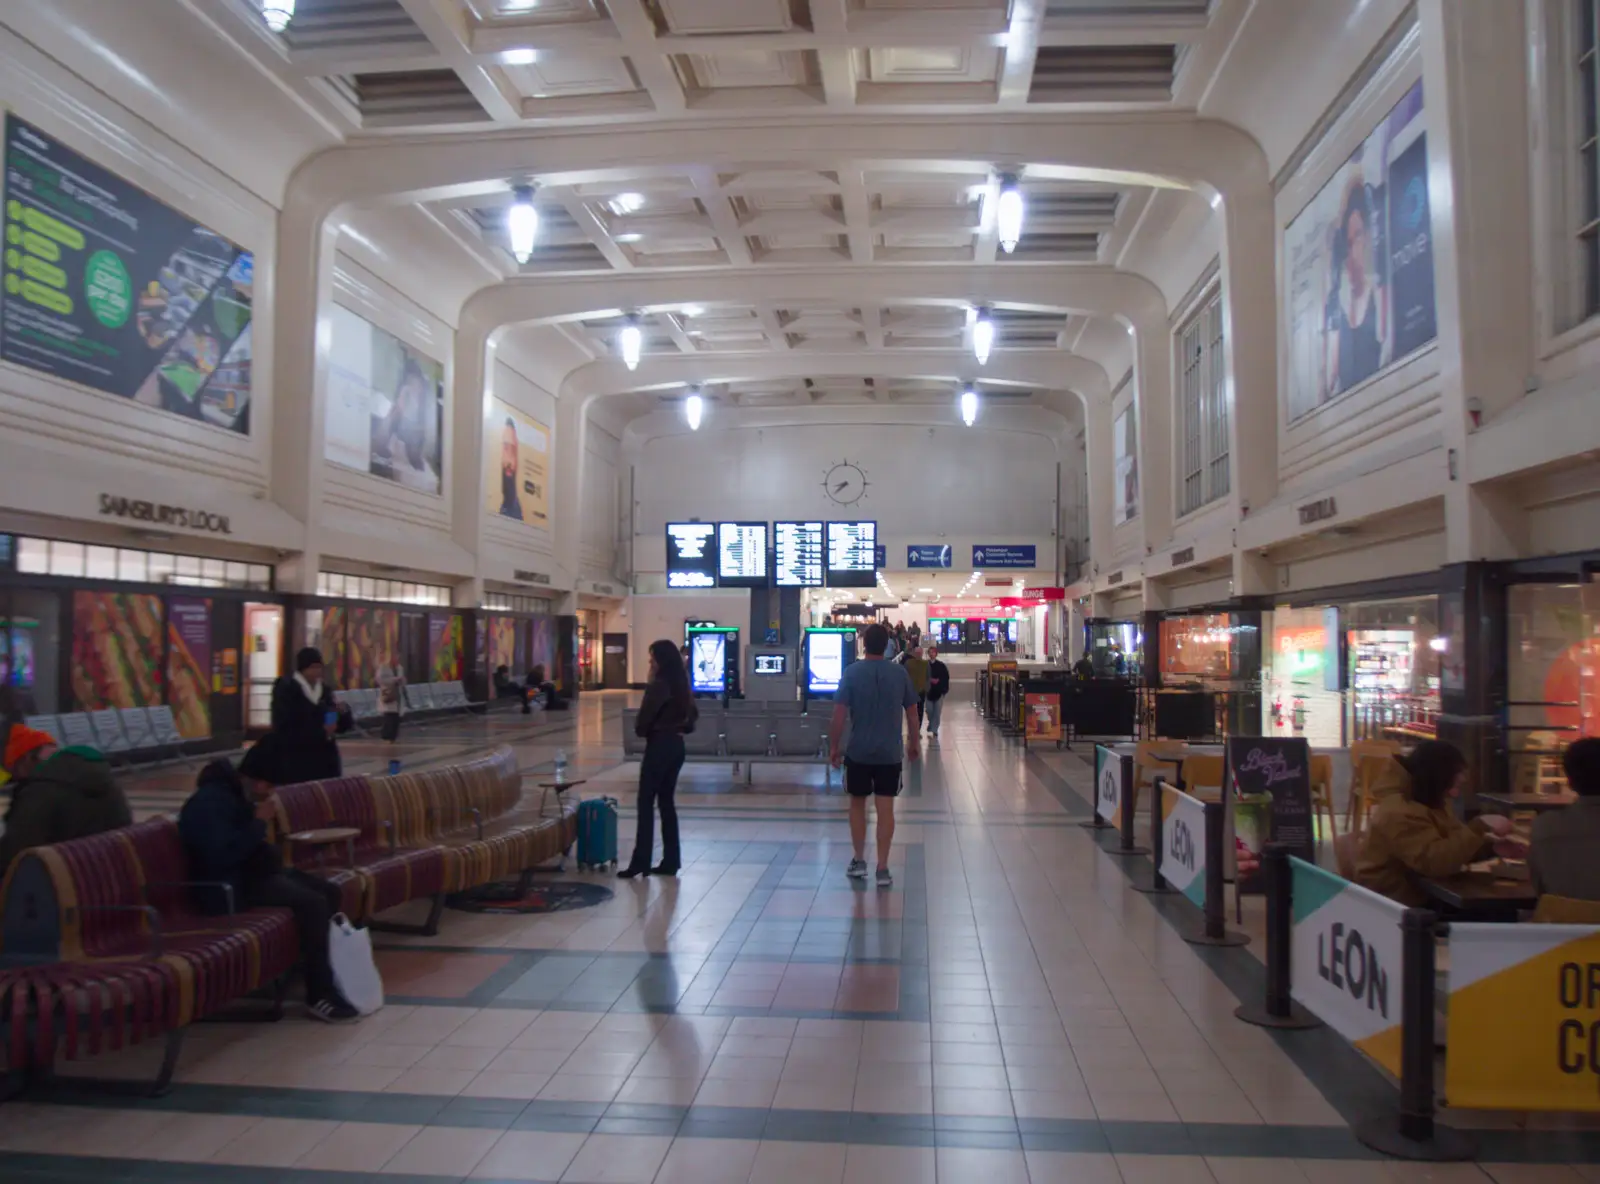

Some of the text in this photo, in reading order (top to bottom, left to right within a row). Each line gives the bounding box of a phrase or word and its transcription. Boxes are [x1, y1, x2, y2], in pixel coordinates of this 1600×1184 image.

[99, 494, 232, 534] SAINSBURY'S LOCAL
[1102, 770, 1117, 804] LEON
[1170, 820, 1195, 872] LEON
[1317, 922, 1389, 1019] LEON
